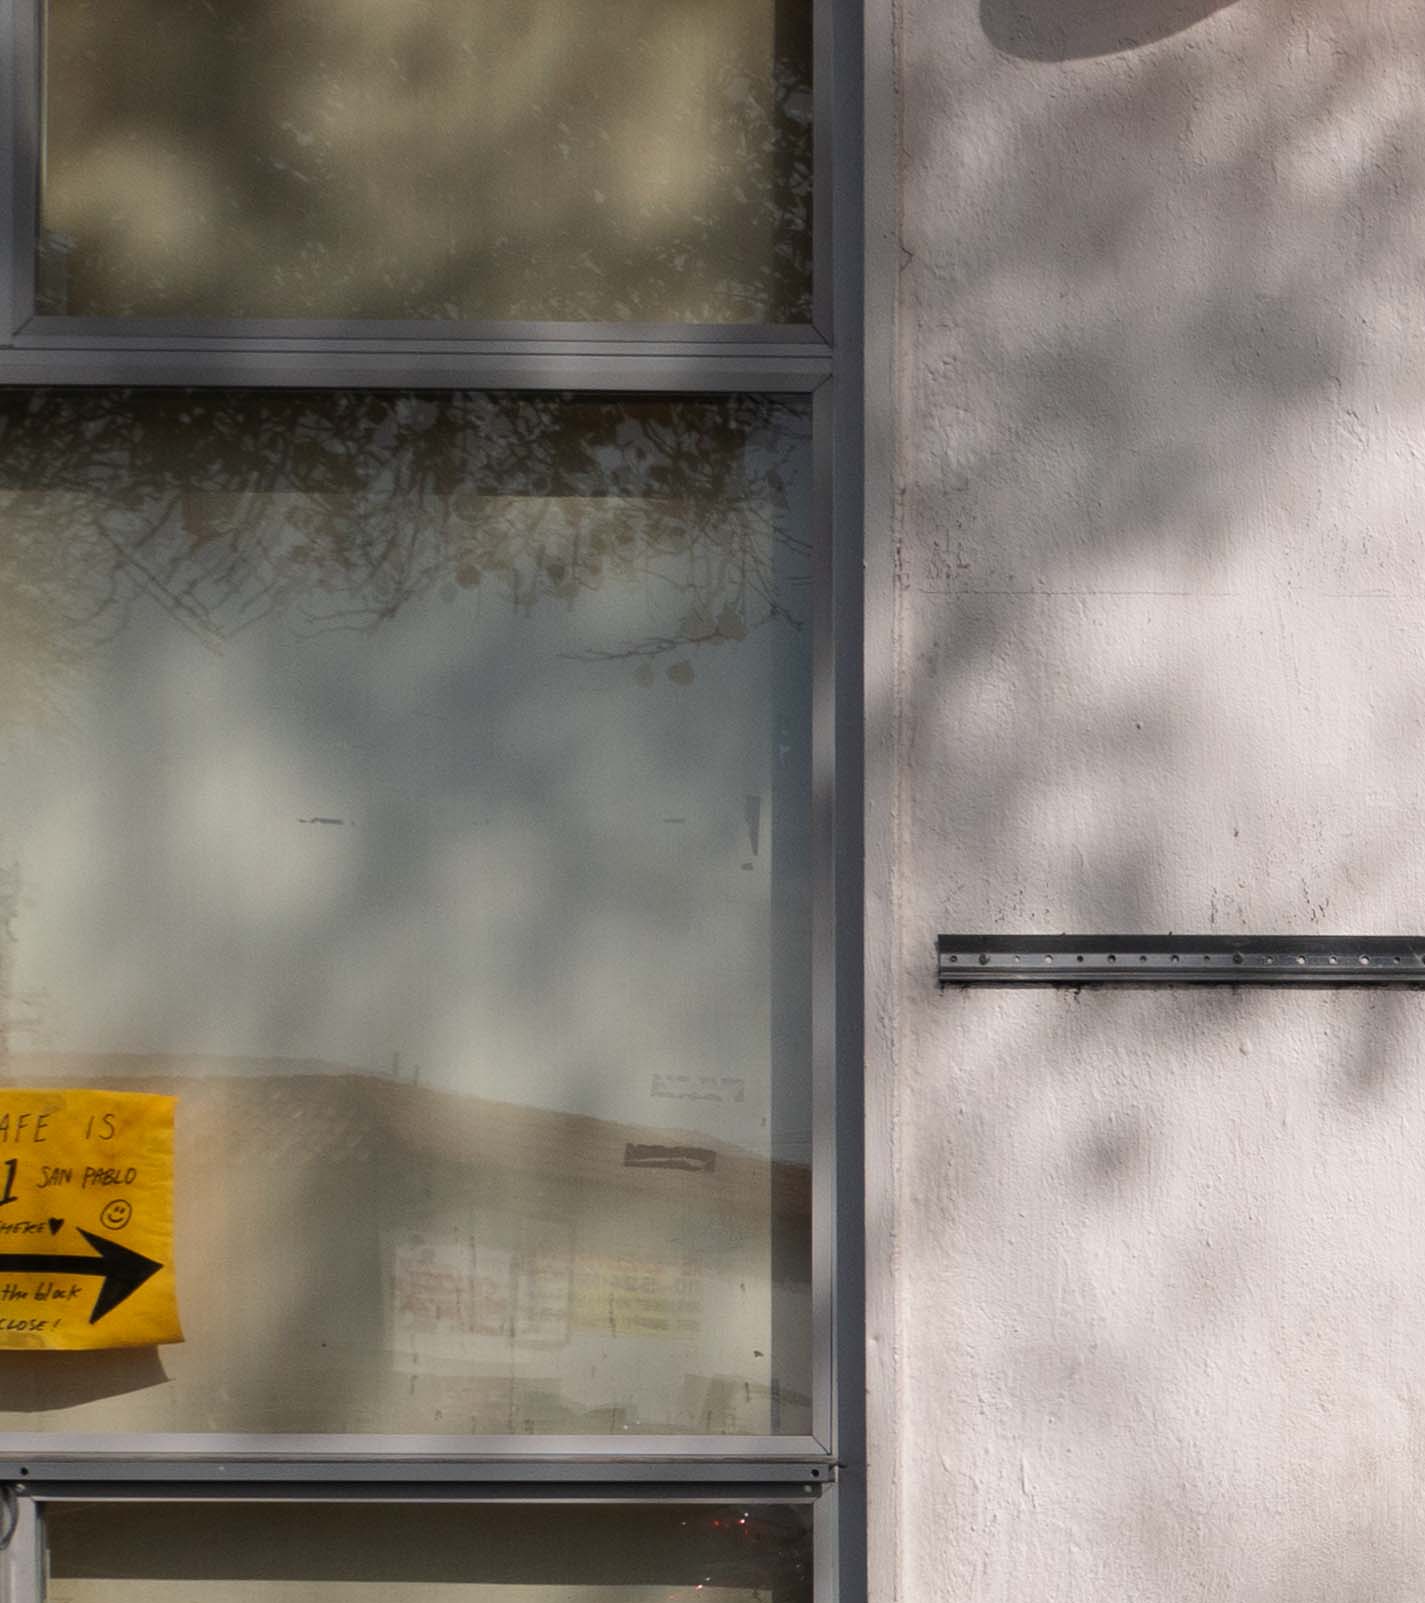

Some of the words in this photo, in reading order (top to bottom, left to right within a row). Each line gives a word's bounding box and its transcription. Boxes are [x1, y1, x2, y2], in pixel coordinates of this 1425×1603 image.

[86, 1113, 116, 1141] IS
[36, 1166, 72, 1188] SAN
[82, 1166, 137, 1189] PABLO
